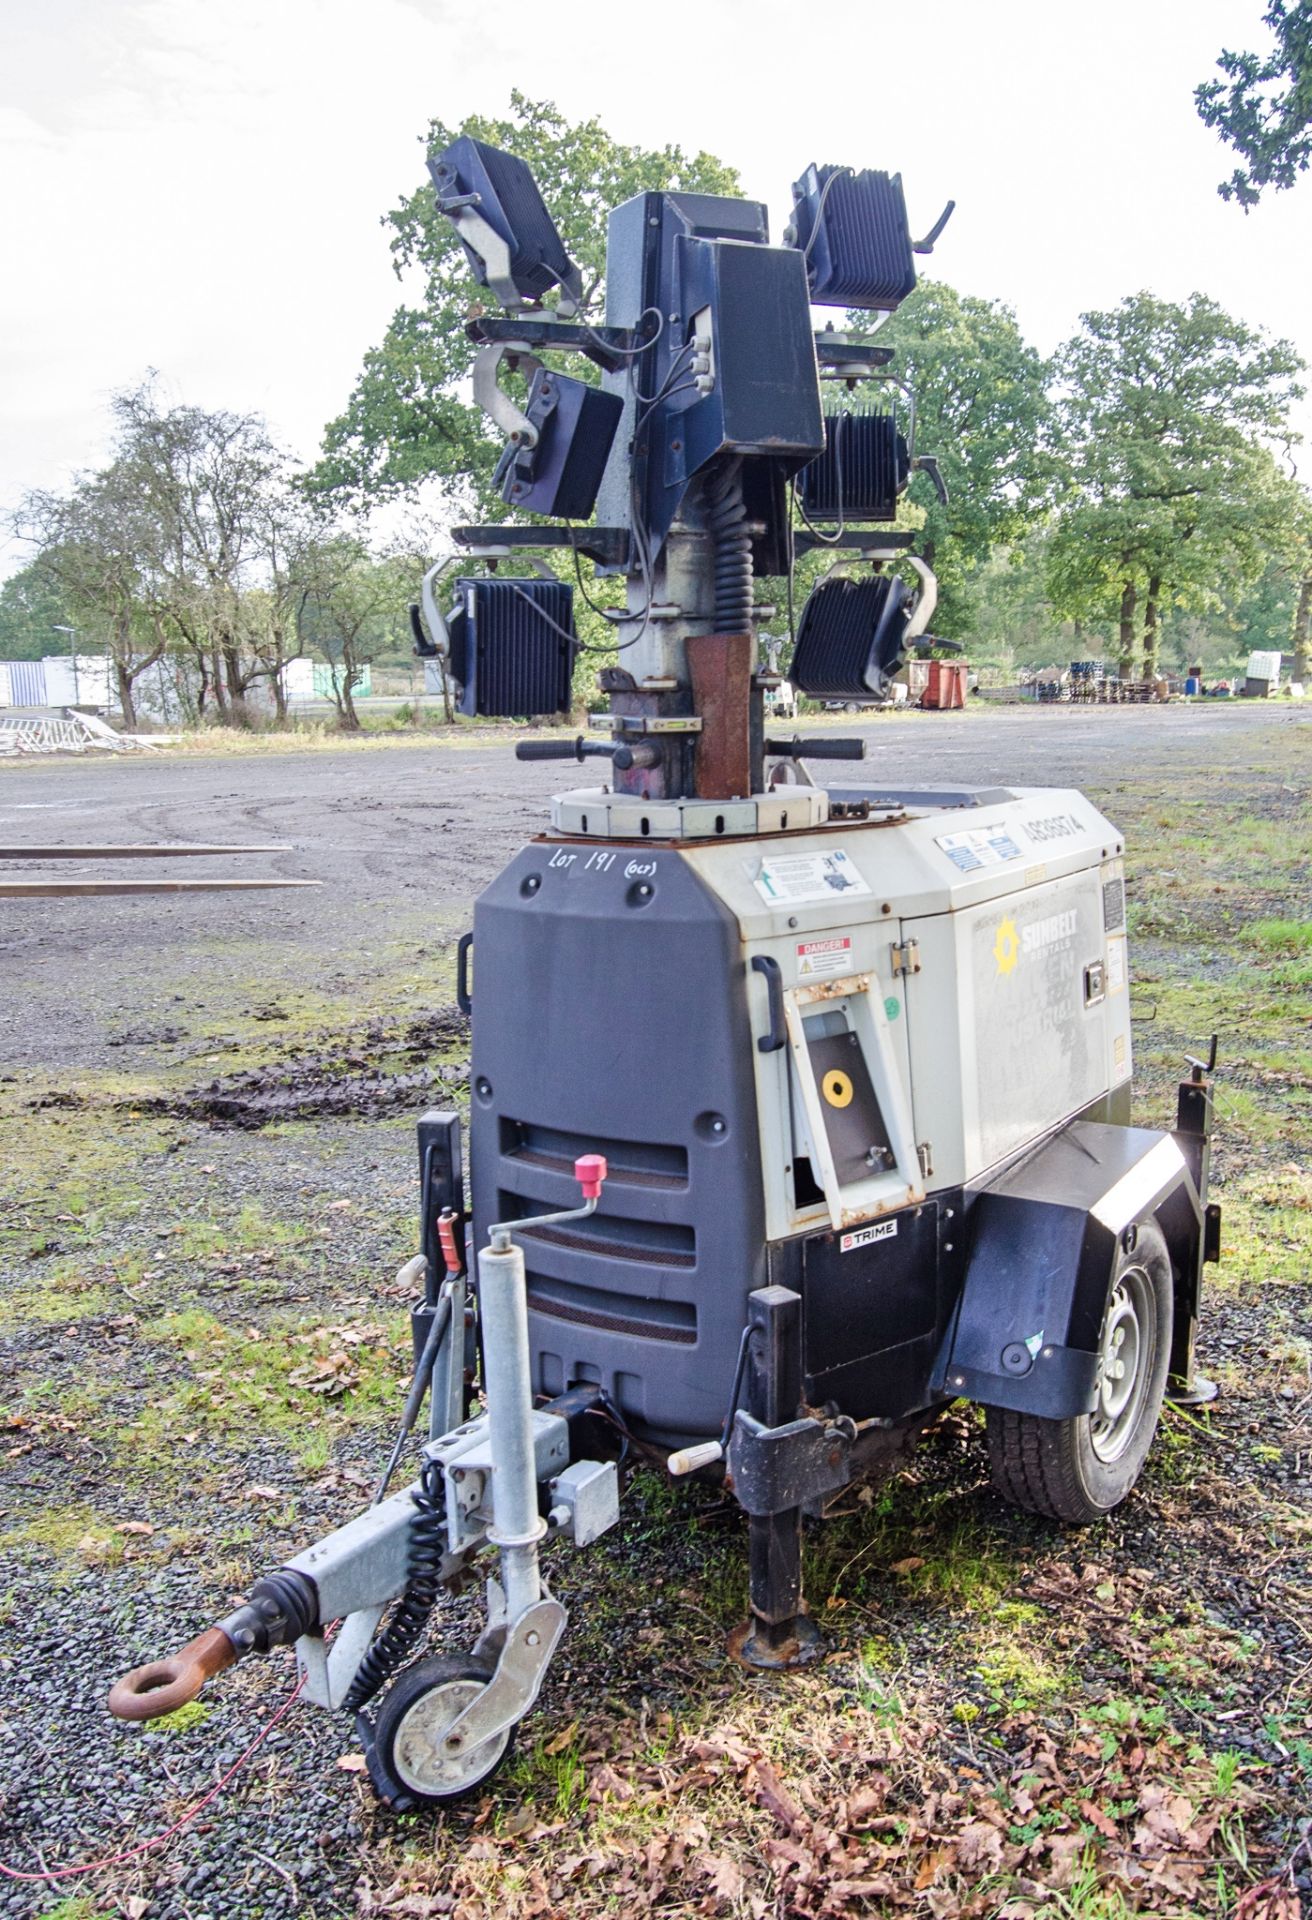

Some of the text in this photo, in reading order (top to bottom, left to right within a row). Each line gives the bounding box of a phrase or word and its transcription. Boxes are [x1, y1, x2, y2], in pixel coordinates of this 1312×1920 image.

[584, 852, 616, 872] 191
[1022, 909, 1077, 953] SUNBELT
[804, 938, 844, 954] DANGER!
[854, 1223, 894, 1243] TRIME
